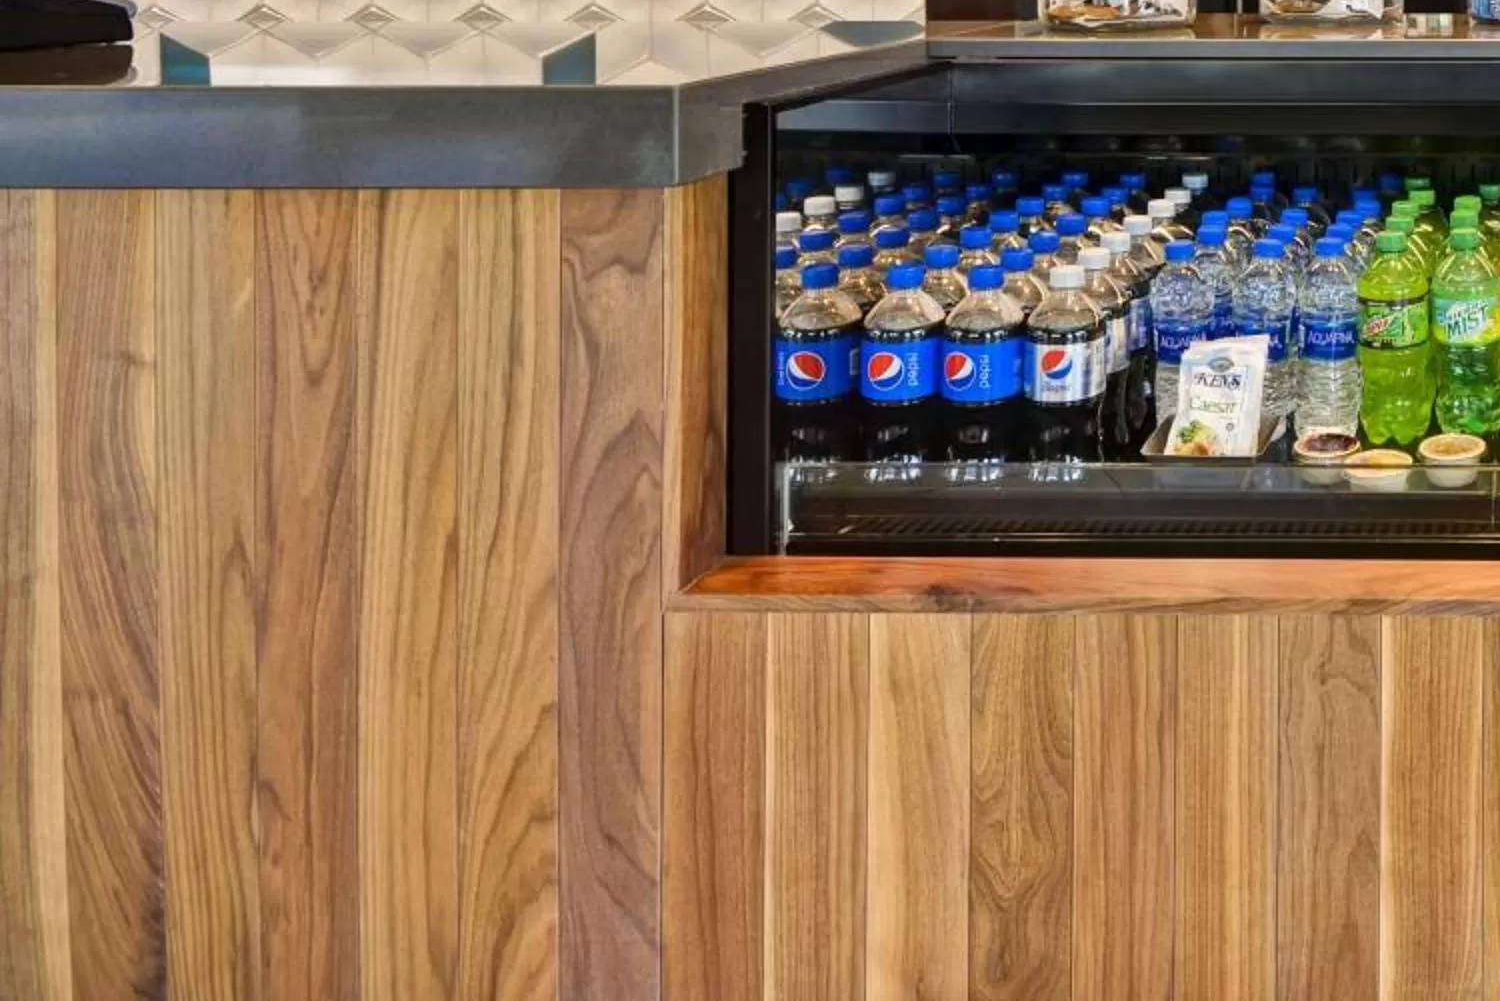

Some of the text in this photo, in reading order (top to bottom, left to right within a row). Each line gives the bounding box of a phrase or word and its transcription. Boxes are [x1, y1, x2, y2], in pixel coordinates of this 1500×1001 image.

[1446, 303, 1489, 340] MIST
[907, 352, 920, 387] pepsi
[978, 354, 993, 390] pepsi
